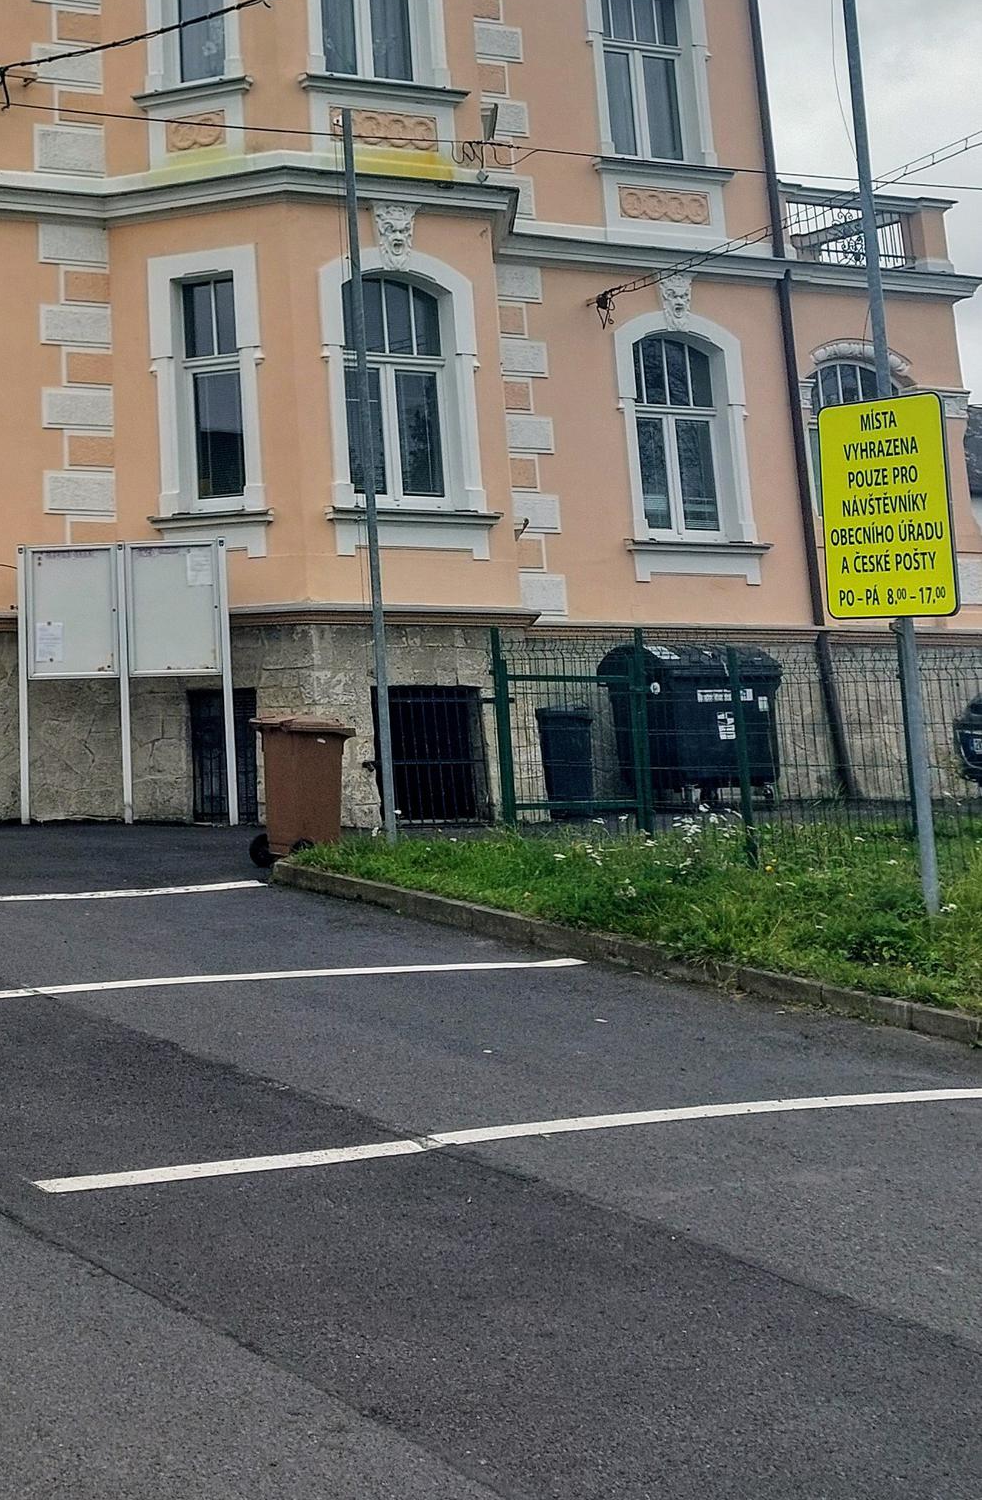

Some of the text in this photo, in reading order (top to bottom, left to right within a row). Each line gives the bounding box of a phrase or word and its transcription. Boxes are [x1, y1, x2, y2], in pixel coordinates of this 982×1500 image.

[860, 409, 897, 431] MÍSTA
[843, 436, 918, 461] VYHRAZENA
[848, 465, 918, 489] POUZE PRO
[842, 489, 927, 517] NÁVŠTĚVNÍKY
[830, 519, 943, 546] OBECNÍHO ÚŘADU
[841, 548, 936, 574] A ČESKÉ POŠTY
[839, 589, 855, 607] PO
[865, 585, 880, 605] PÁ
